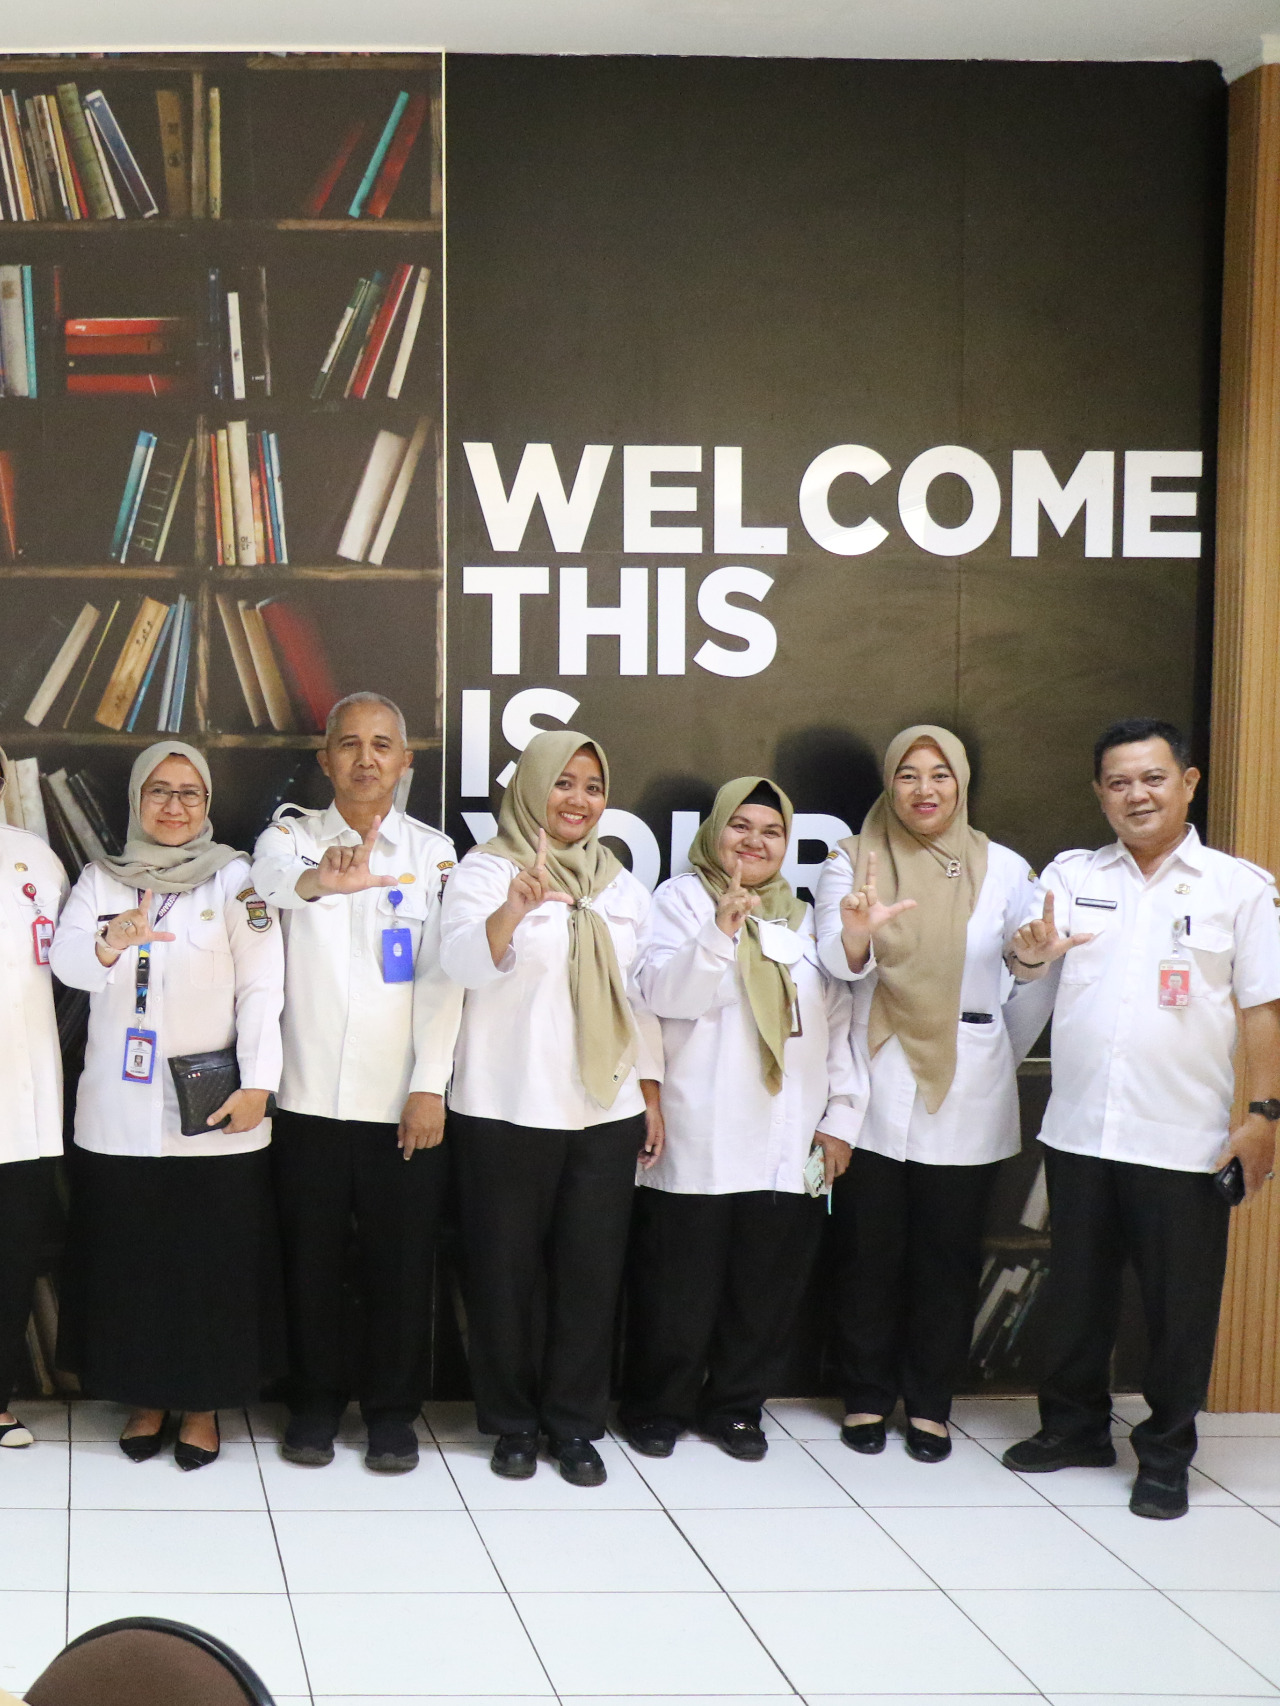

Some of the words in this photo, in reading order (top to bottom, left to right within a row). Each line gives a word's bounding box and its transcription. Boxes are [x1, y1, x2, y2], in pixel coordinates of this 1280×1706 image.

[463, 442, 1203, 558] WELCOME
[463, 566, 778, 678] THIS
[461, 688, 581, 798] IS
[461, 808, 854, 903] OR
